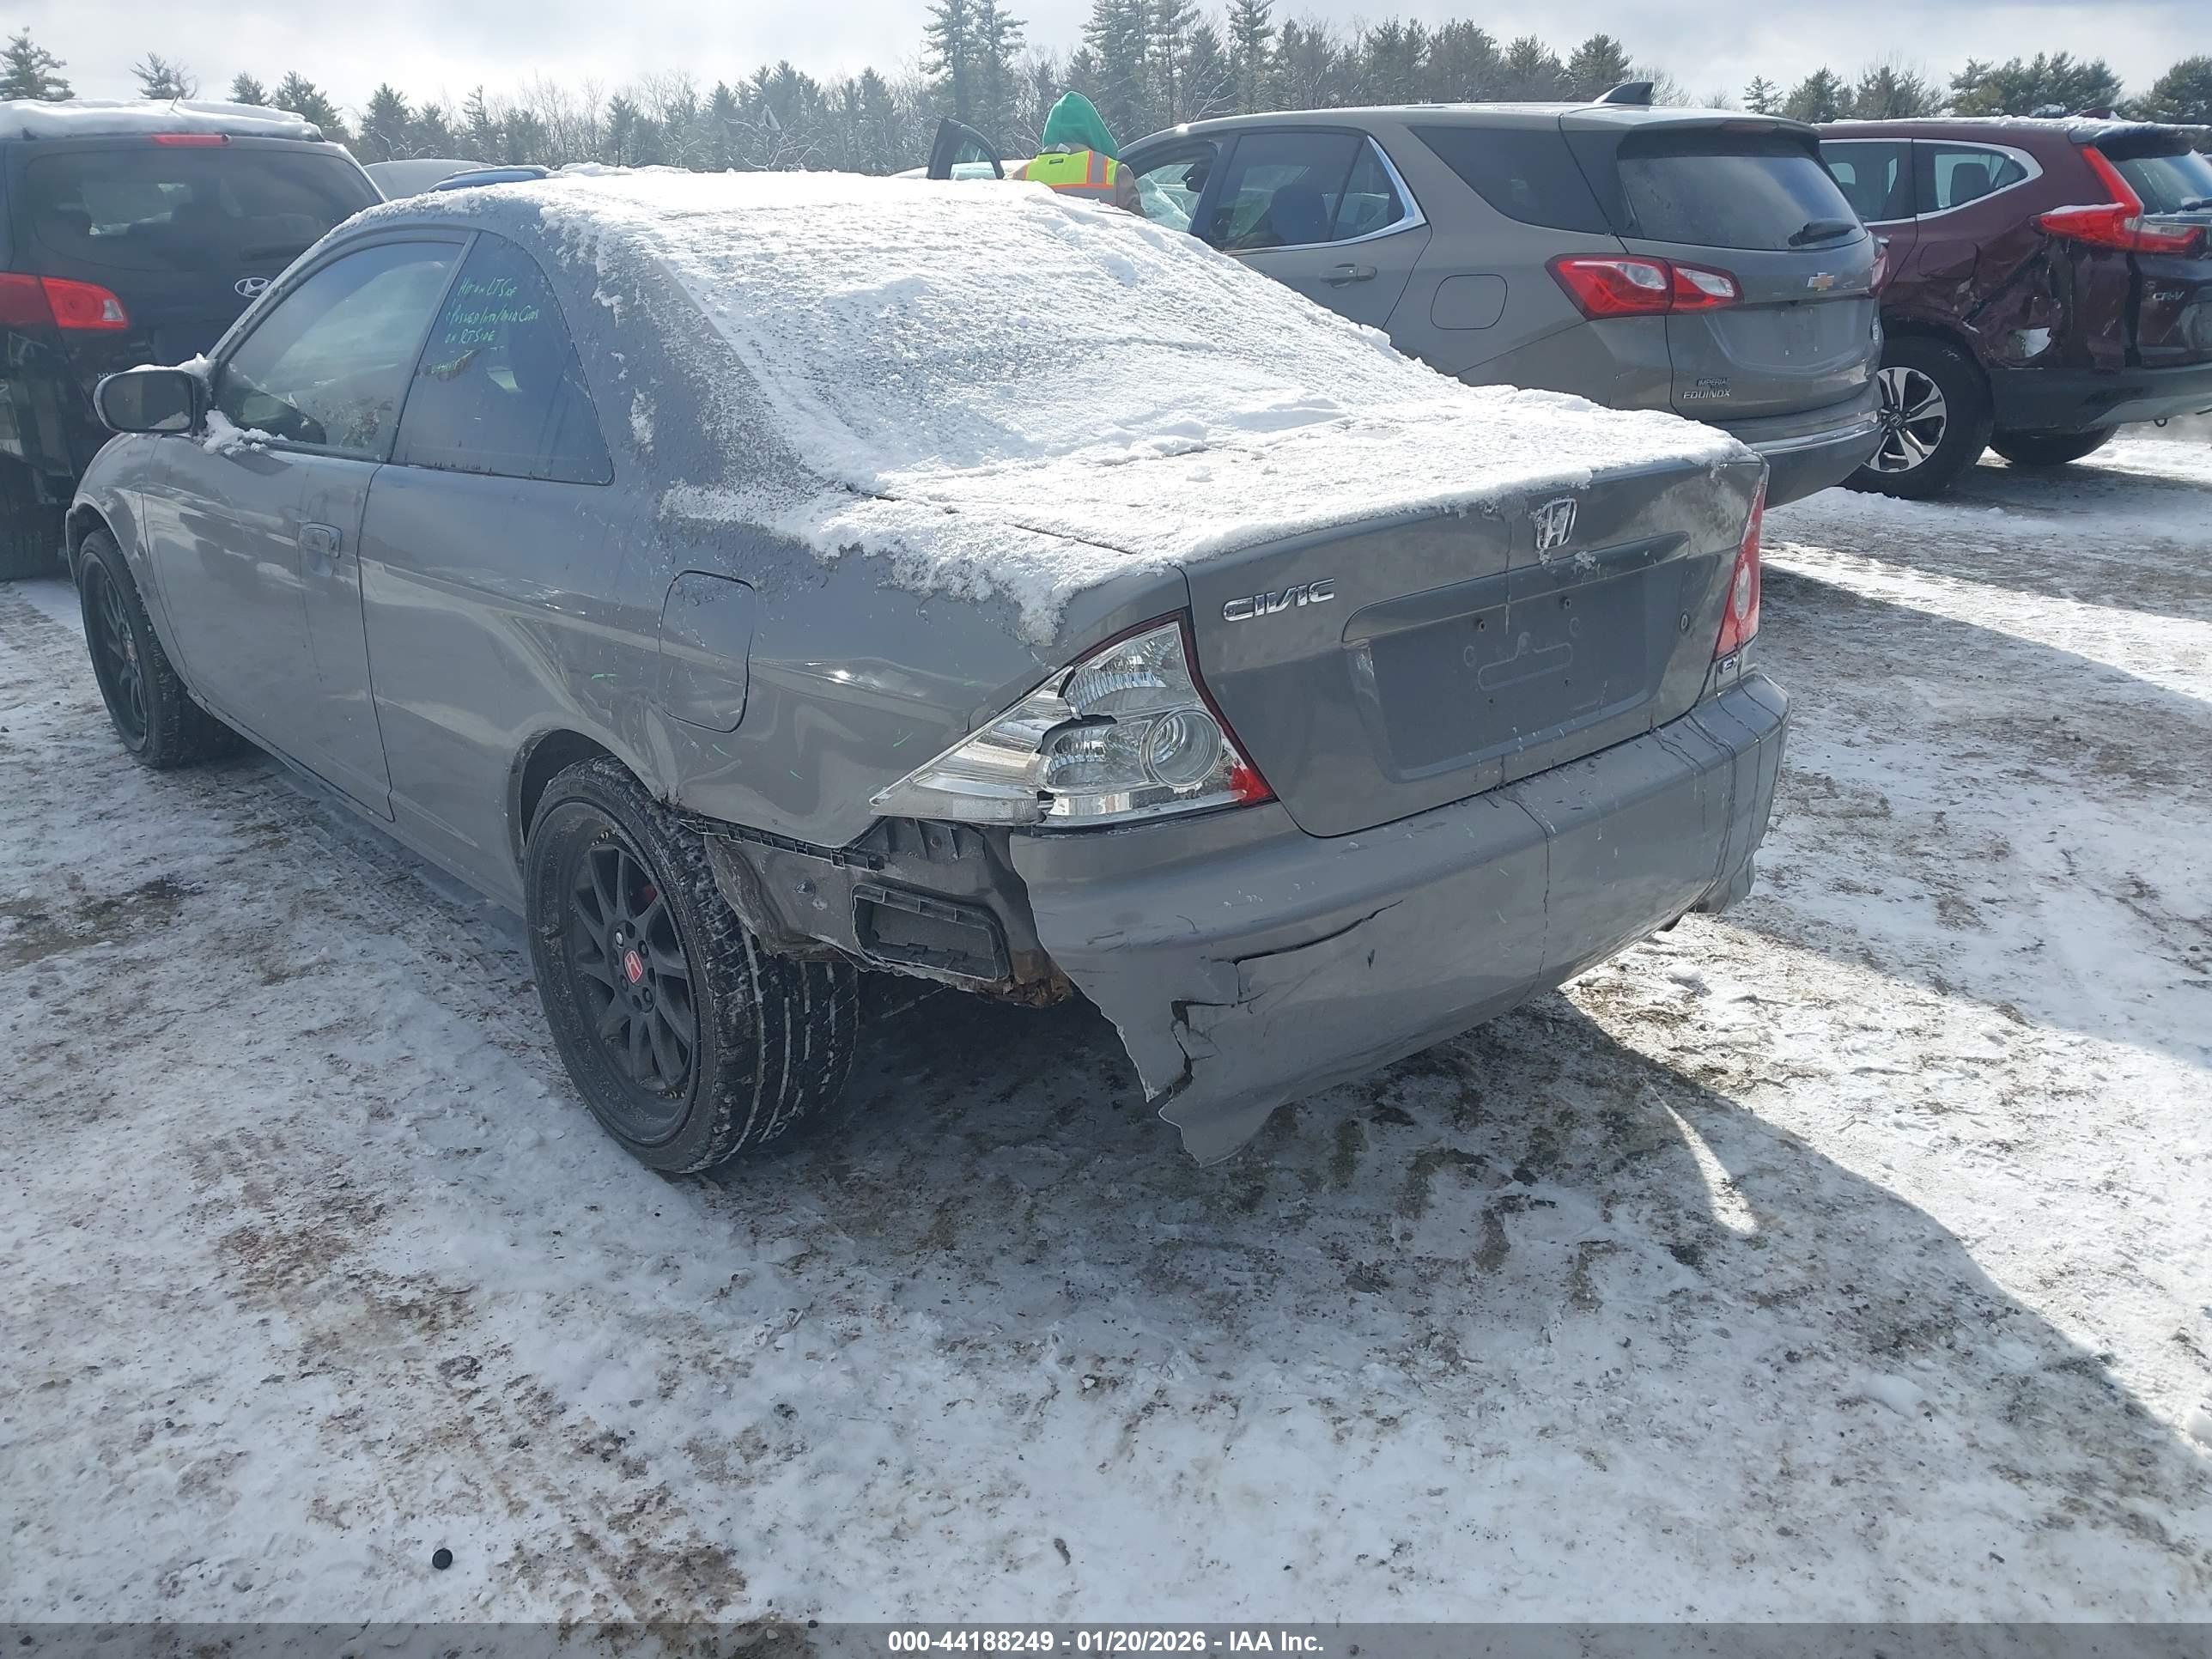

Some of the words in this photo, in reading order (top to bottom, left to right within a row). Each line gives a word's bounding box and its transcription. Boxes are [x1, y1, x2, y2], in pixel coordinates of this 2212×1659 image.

[2152, 290, 2185, 301] CR-V
[1683, 388, 1731, 399] EQUINOX
[1223, 578, 1334, 622] CIVIC
